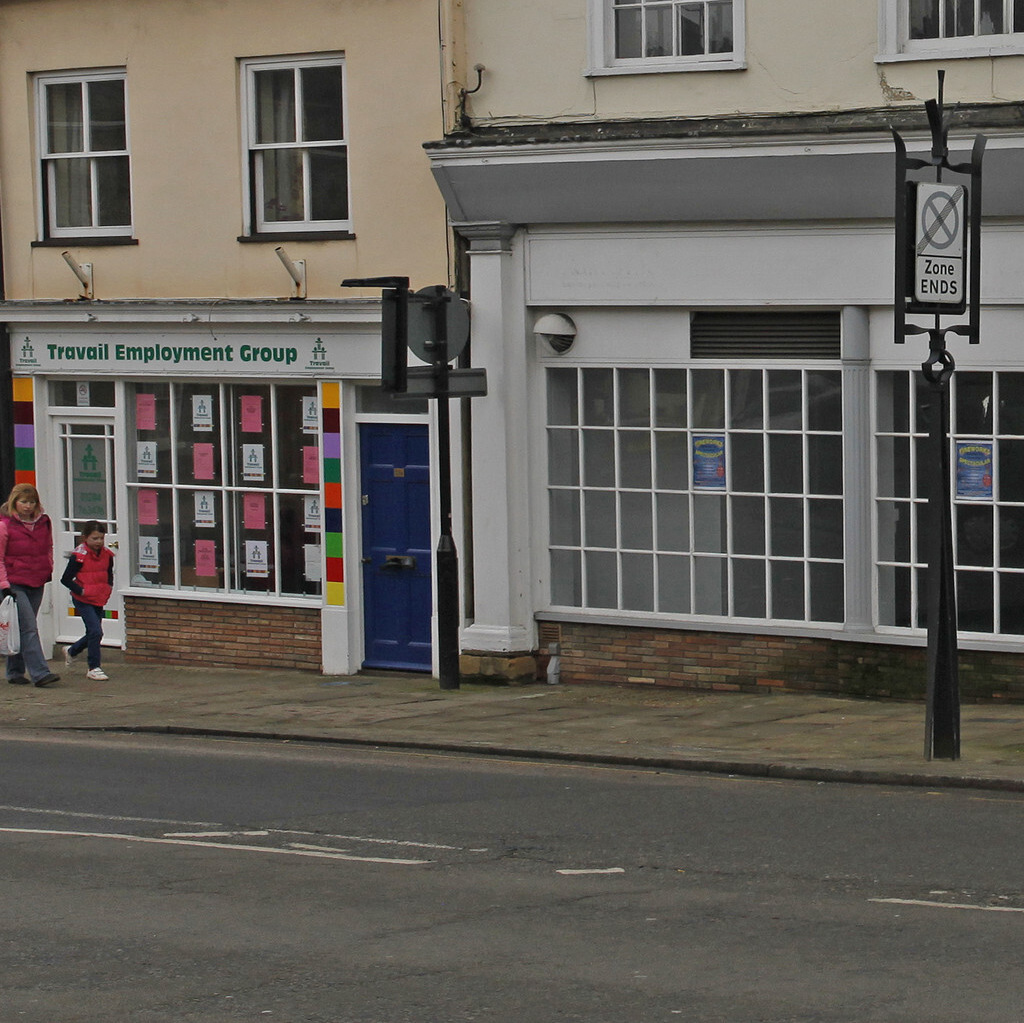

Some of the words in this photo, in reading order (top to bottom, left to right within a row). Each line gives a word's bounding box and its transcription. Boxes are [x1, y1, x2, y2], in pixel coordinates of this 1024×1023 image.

[925, 259, 954, 275] Zone
[921, 279, 958, 295] ENDS
[47, 343, 109, 361] Travail
[115, 343, 234, 364] Employment
[240, 344, 298, 365] Group
